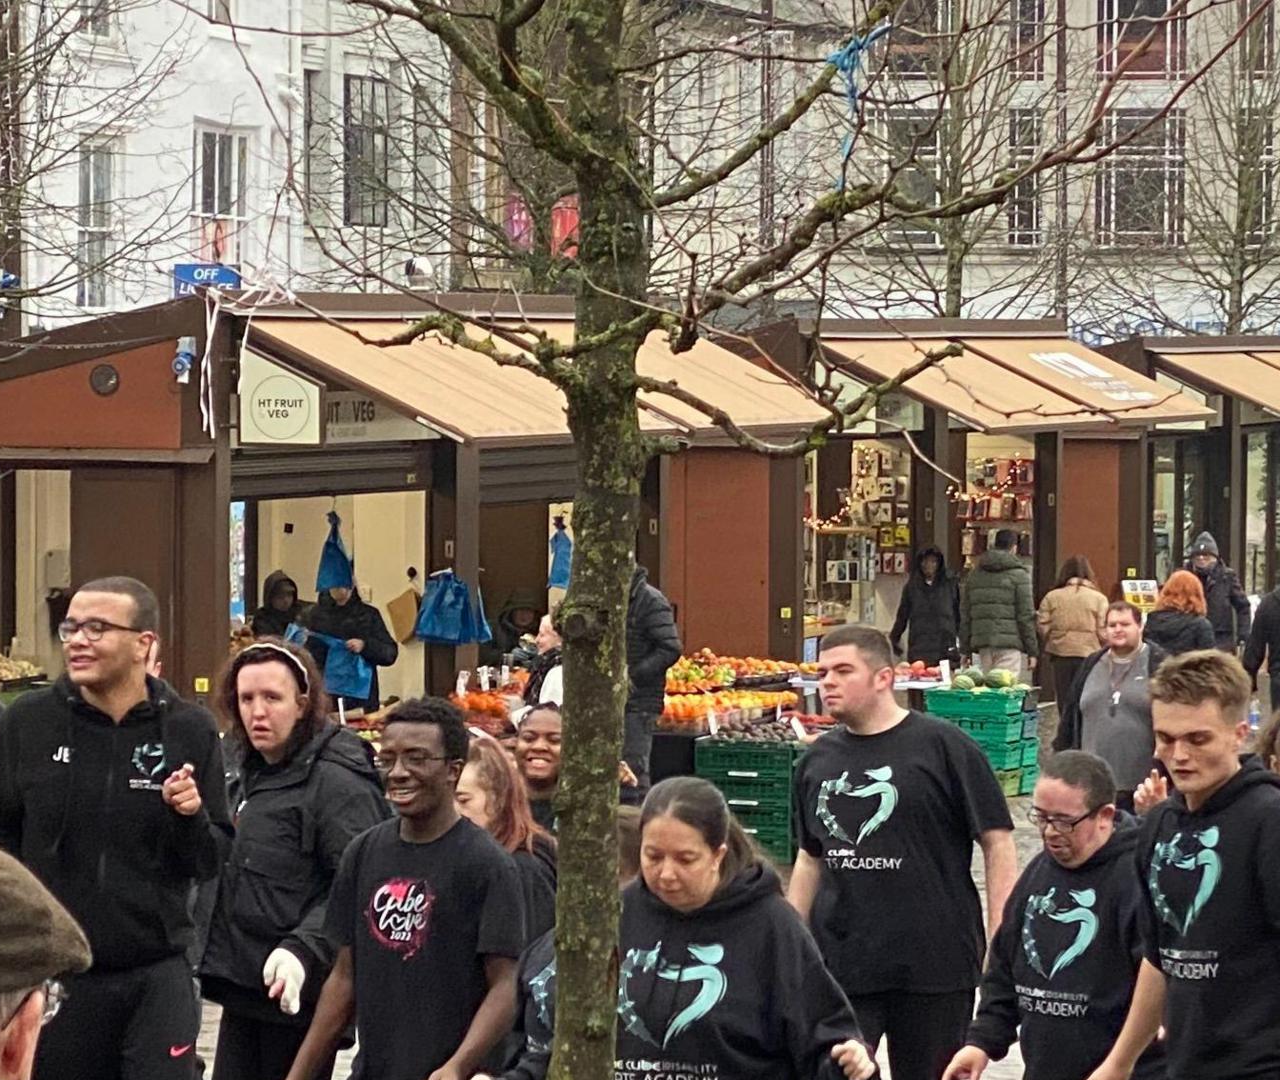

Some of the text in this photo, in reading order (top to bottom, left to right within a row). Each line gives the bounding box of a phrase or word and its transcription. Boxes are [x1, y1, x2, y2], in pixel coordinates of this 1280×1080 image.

[193, 268, 220, 280] OFF
[258, 399, 304, 408] HT FRUIT
[268, 409, 289, 418] VEG
[353, 401, 375, 422] VEG
[841, 857, 902, 870] ACADEMY
[1035, 1000, 1089, 1016] ACADEMY
